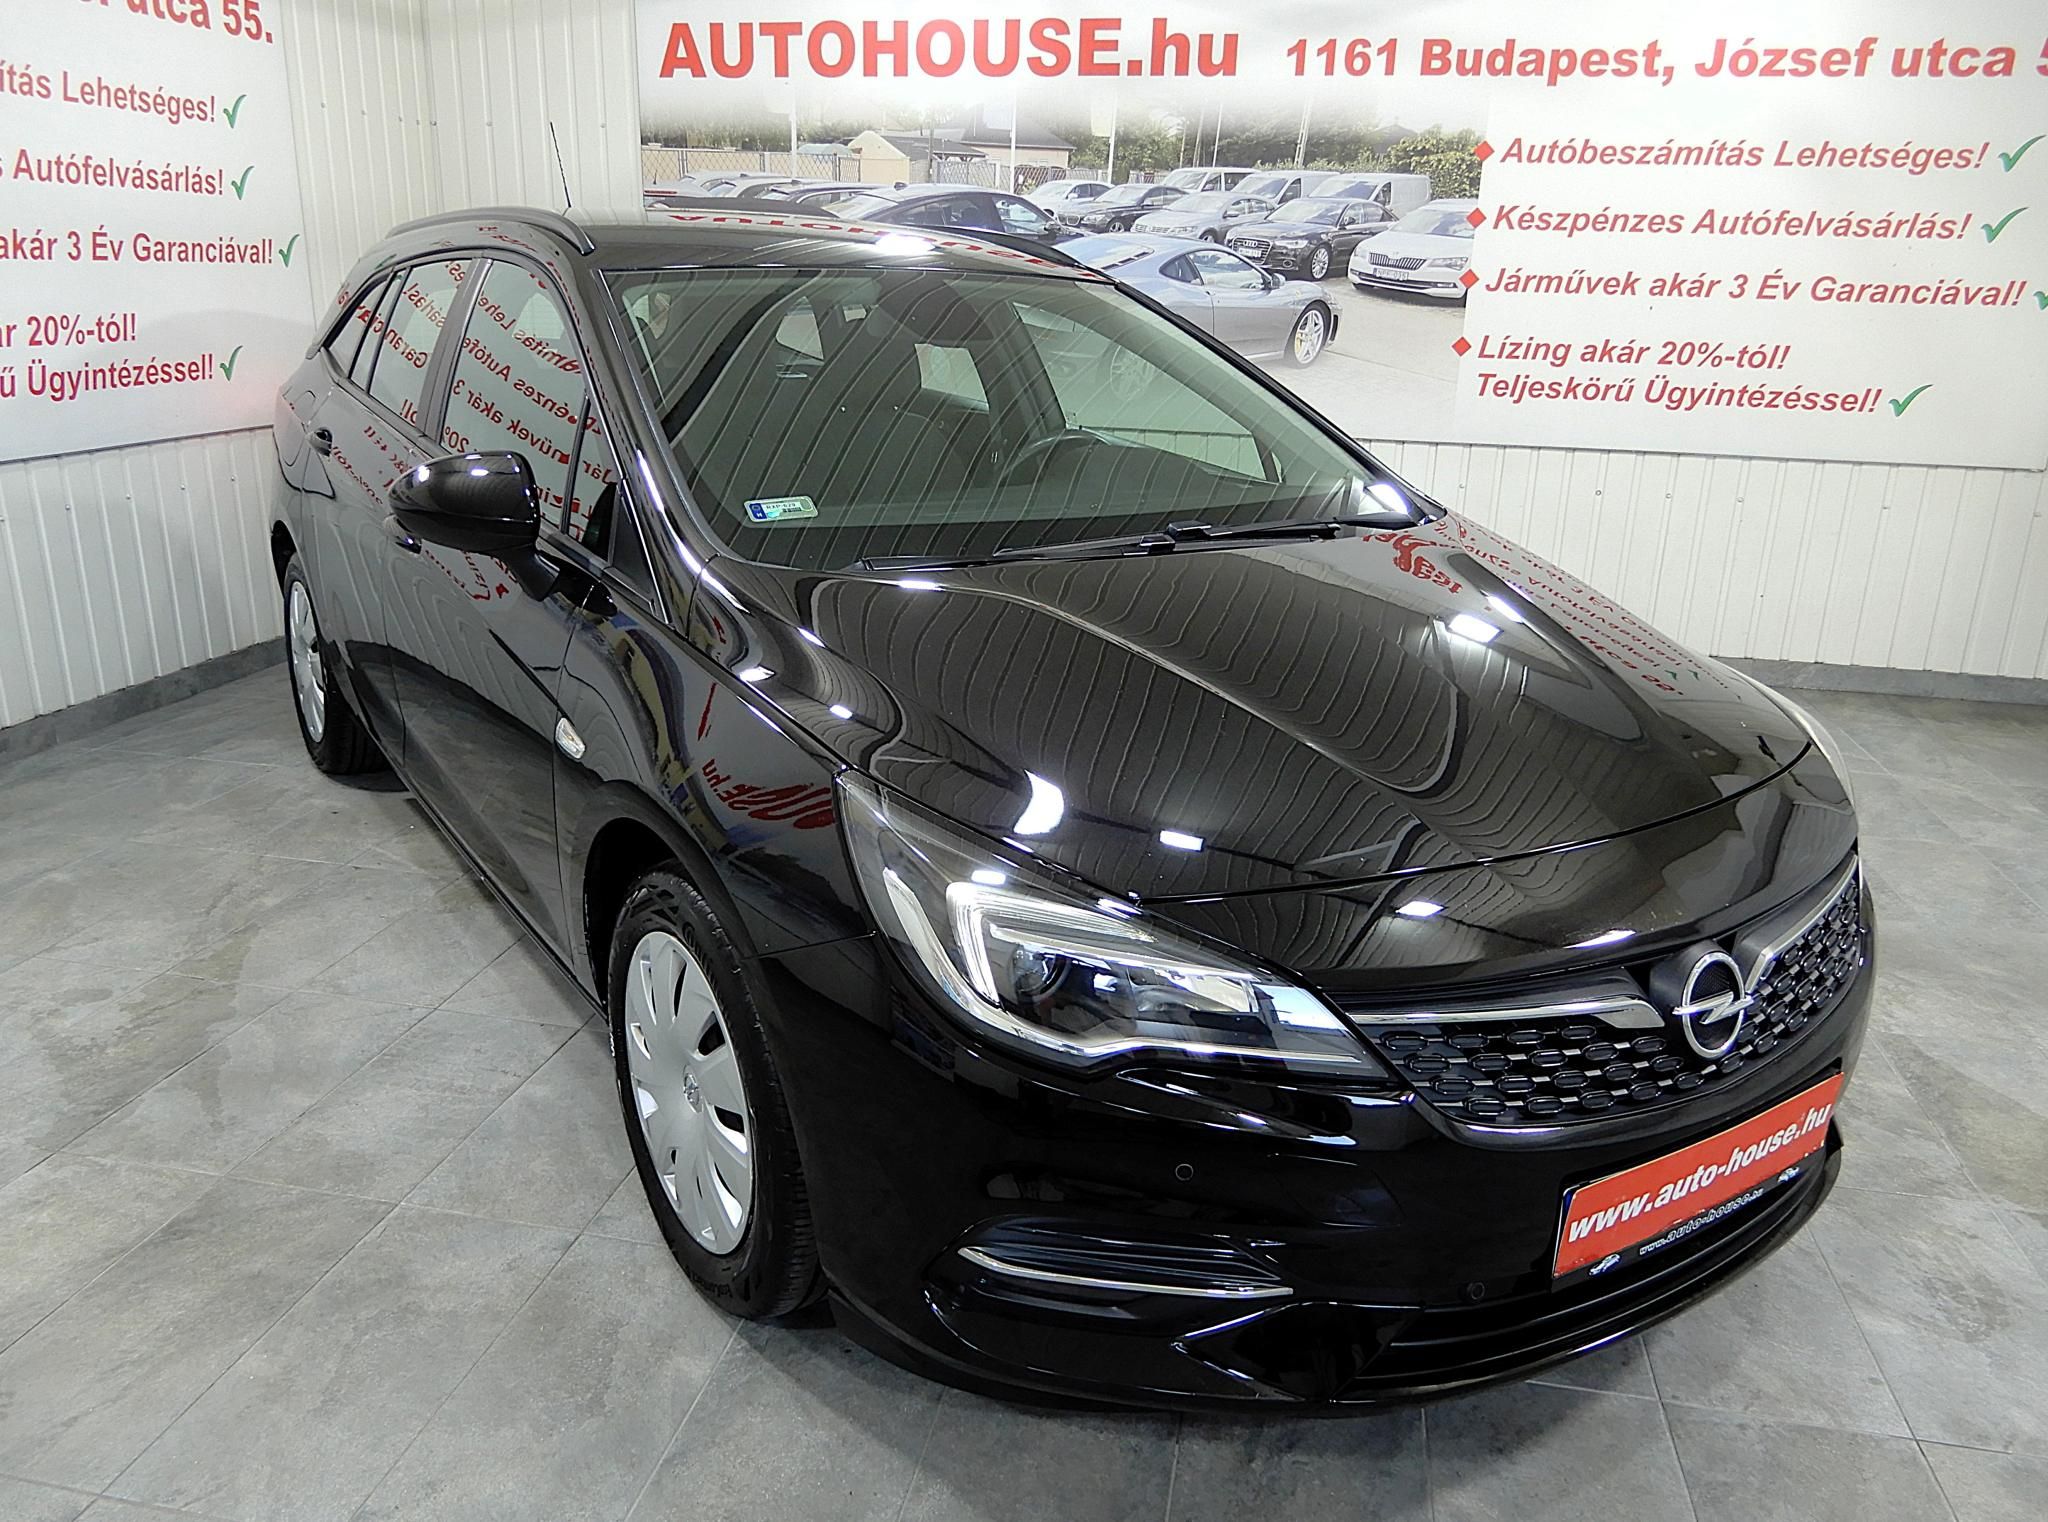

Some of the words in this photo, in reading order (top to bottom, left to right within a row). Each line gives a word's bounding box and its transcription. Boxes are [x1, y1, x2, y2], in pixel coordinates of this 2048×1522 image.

[222, 0, 273, 43] 55.
[659, 16, 1239, 79] AUTOHOUSE.hu
[1286, 37, 1398, 77] 1161
[1420, 37, 1675, 87] Budapest,
[1694, 37, 1879, 78] József
[1891, 38, 2017, 79] utca
[63, 70, 215, 126] Lehetséges!
[13, 148, 224, 196] Autófelvásárlás!
[1501, 137, 1764, 168] Autóbeszámítás
[1774, 140, 1990, 176] Lehetséges!
[1492, 205, 1686, 239] Készpénzes
[1691, 208, 1972, 240] Autófelvásárlás!
[0, 228, 57, 260] akár
[67, 231, 82, 261] 3
[91, 225, 124, 262] Év
[132, 233, 273, 265] Garanciával!
[1484, 267, 1639, 297] Járművek
[1648, 271, 1721, 299] akár
[1727, 273, 1749, 300] 3
[1756, 268, 1801, 302] Év
[1809, 275, 2027, 306] Garanciával!
[0, 324, 17, 348] r
[26, 313, 137, 347] 20%-tól!
[1478, 335, 1573, 368] Lízing
[1579, 338, 1650, 365] akár
[1657, 340, 1792, 370] 20%-tól!
[27, 353, 215, 402] Ügyintézéssel!
[1476, 373, 1635, 405] Teljeskörű
[1644, 375, 1883, 414] Ügyintézéssel!
[1567, 1103, 1832, 1243] www.auto-house.hu
